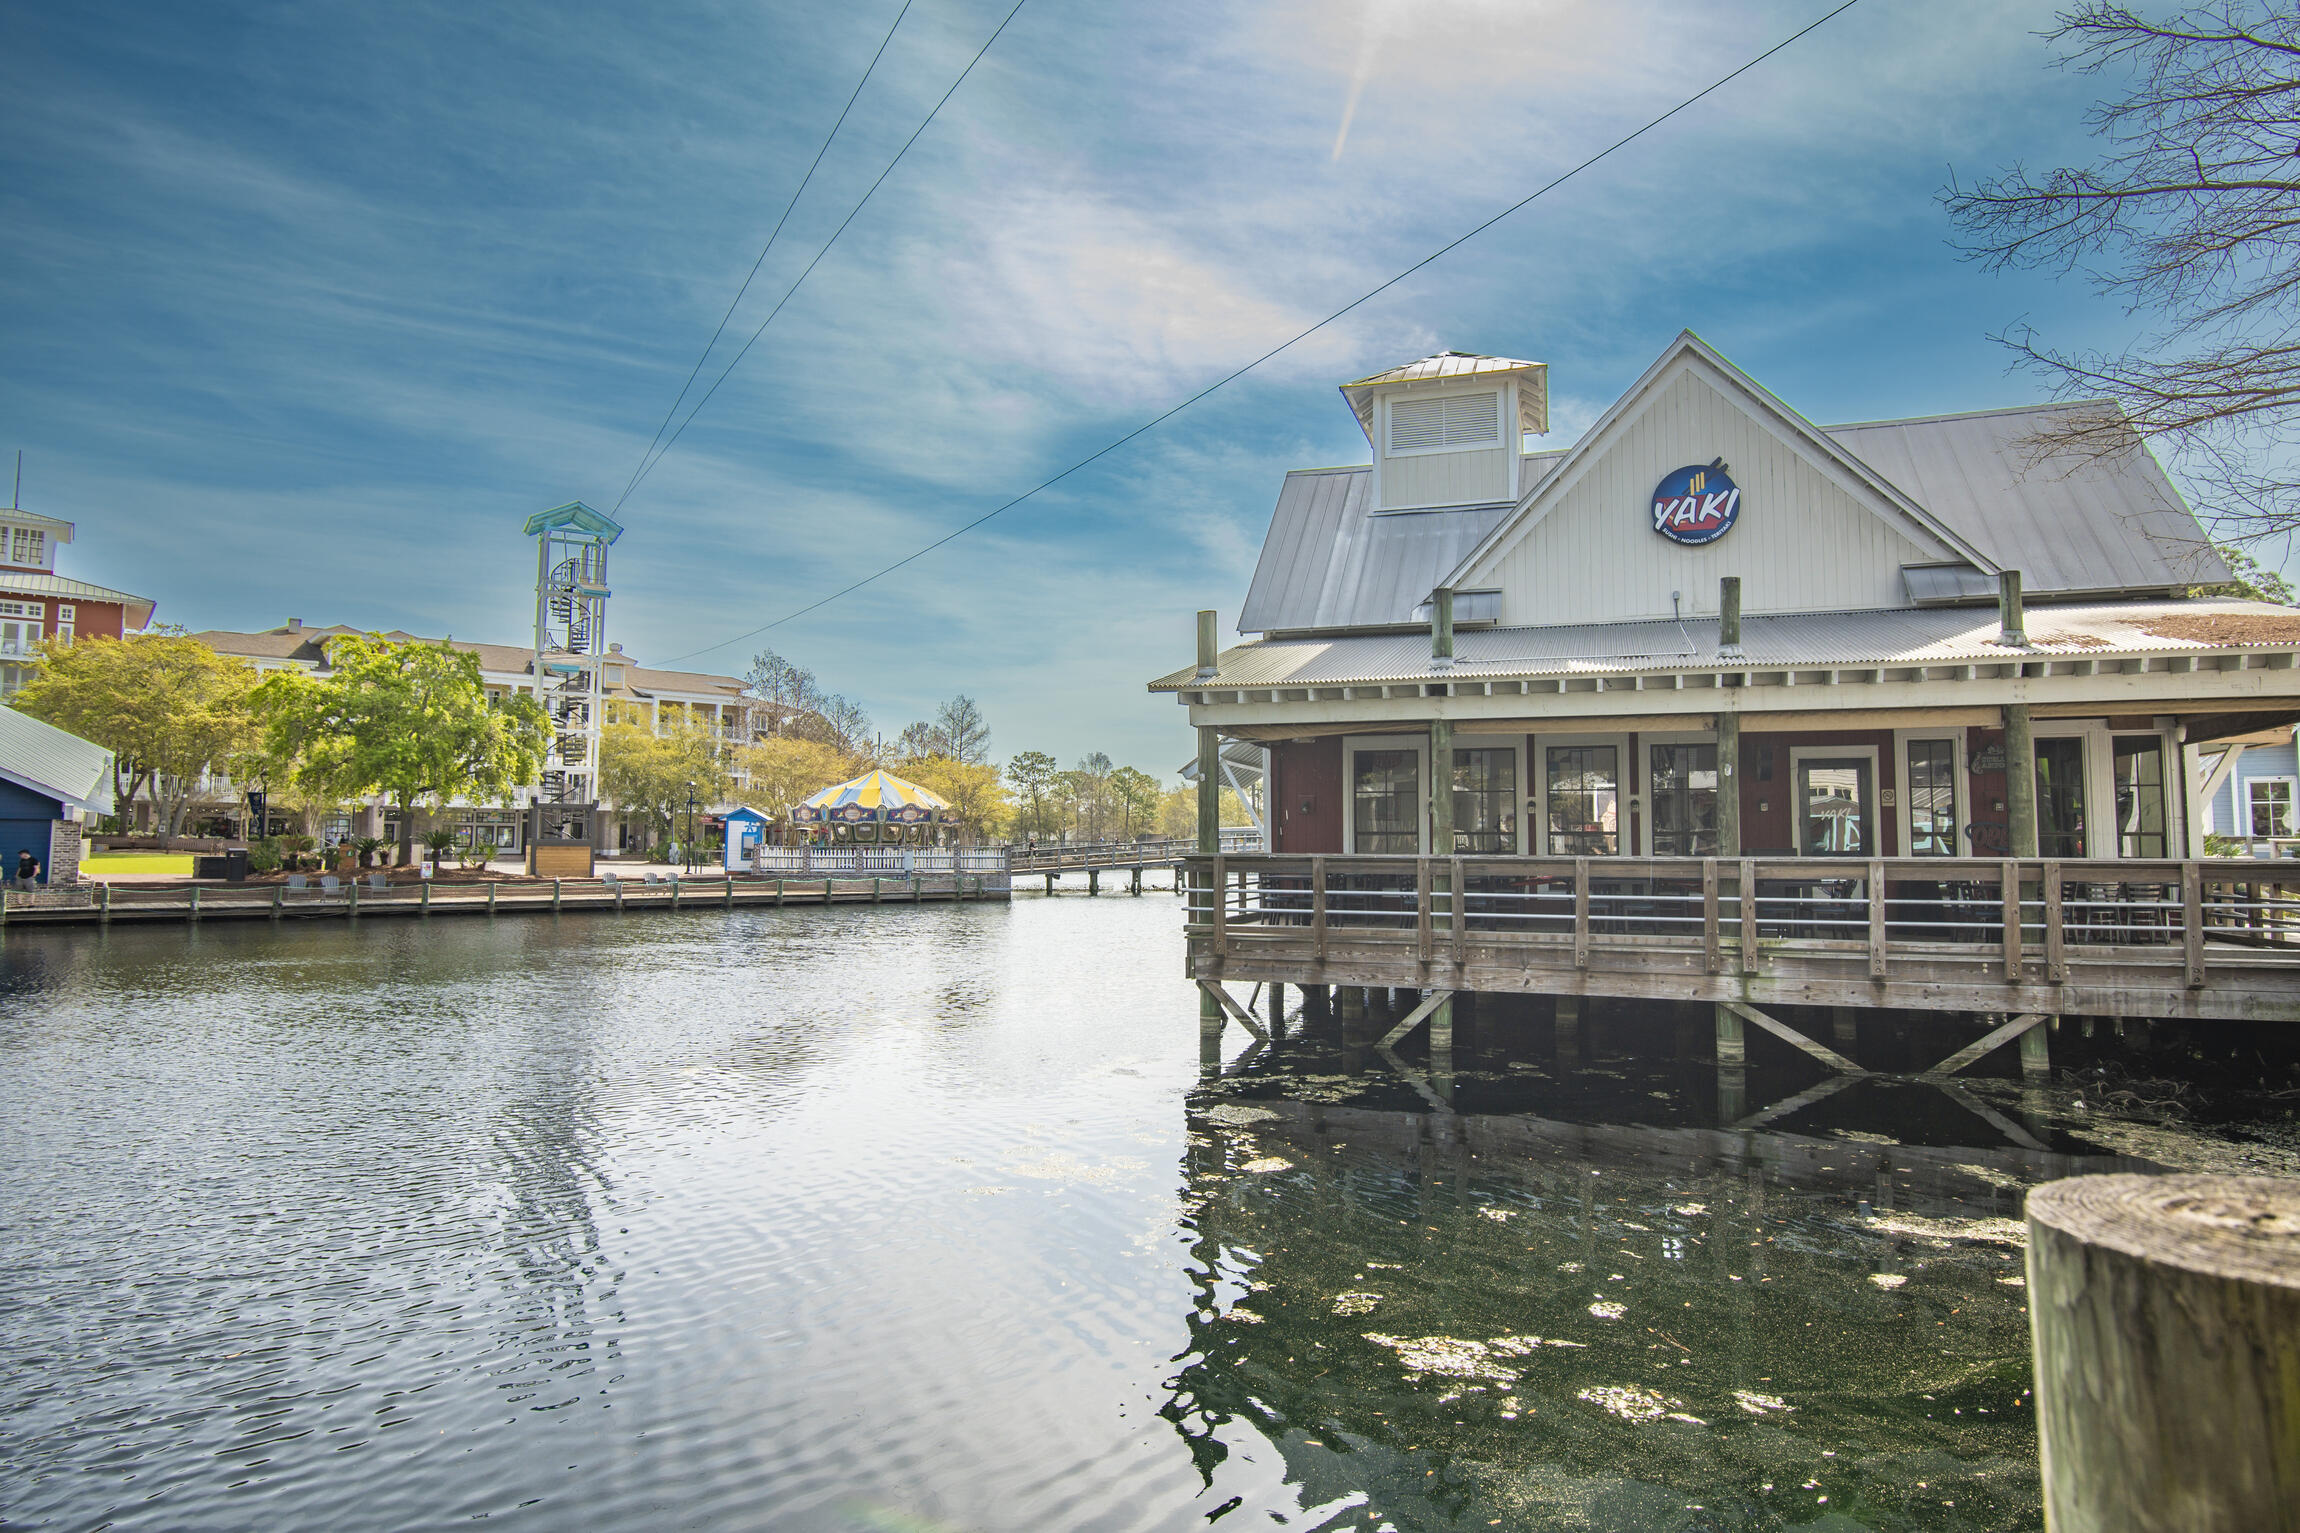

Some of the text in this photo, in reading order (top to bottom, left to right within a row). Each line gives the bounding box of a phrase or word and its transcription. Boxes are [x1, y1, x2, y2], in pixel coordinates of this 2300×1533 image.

[1654, 487, 1740, 531] YAKI
[1662, 527, 1678, 540] SUSHI
[1711, 521, 1732, 539] TERIYAKI
[1821, 807, 1851, 821] YAKI
[1971, 825, 2009, 849] OPE
